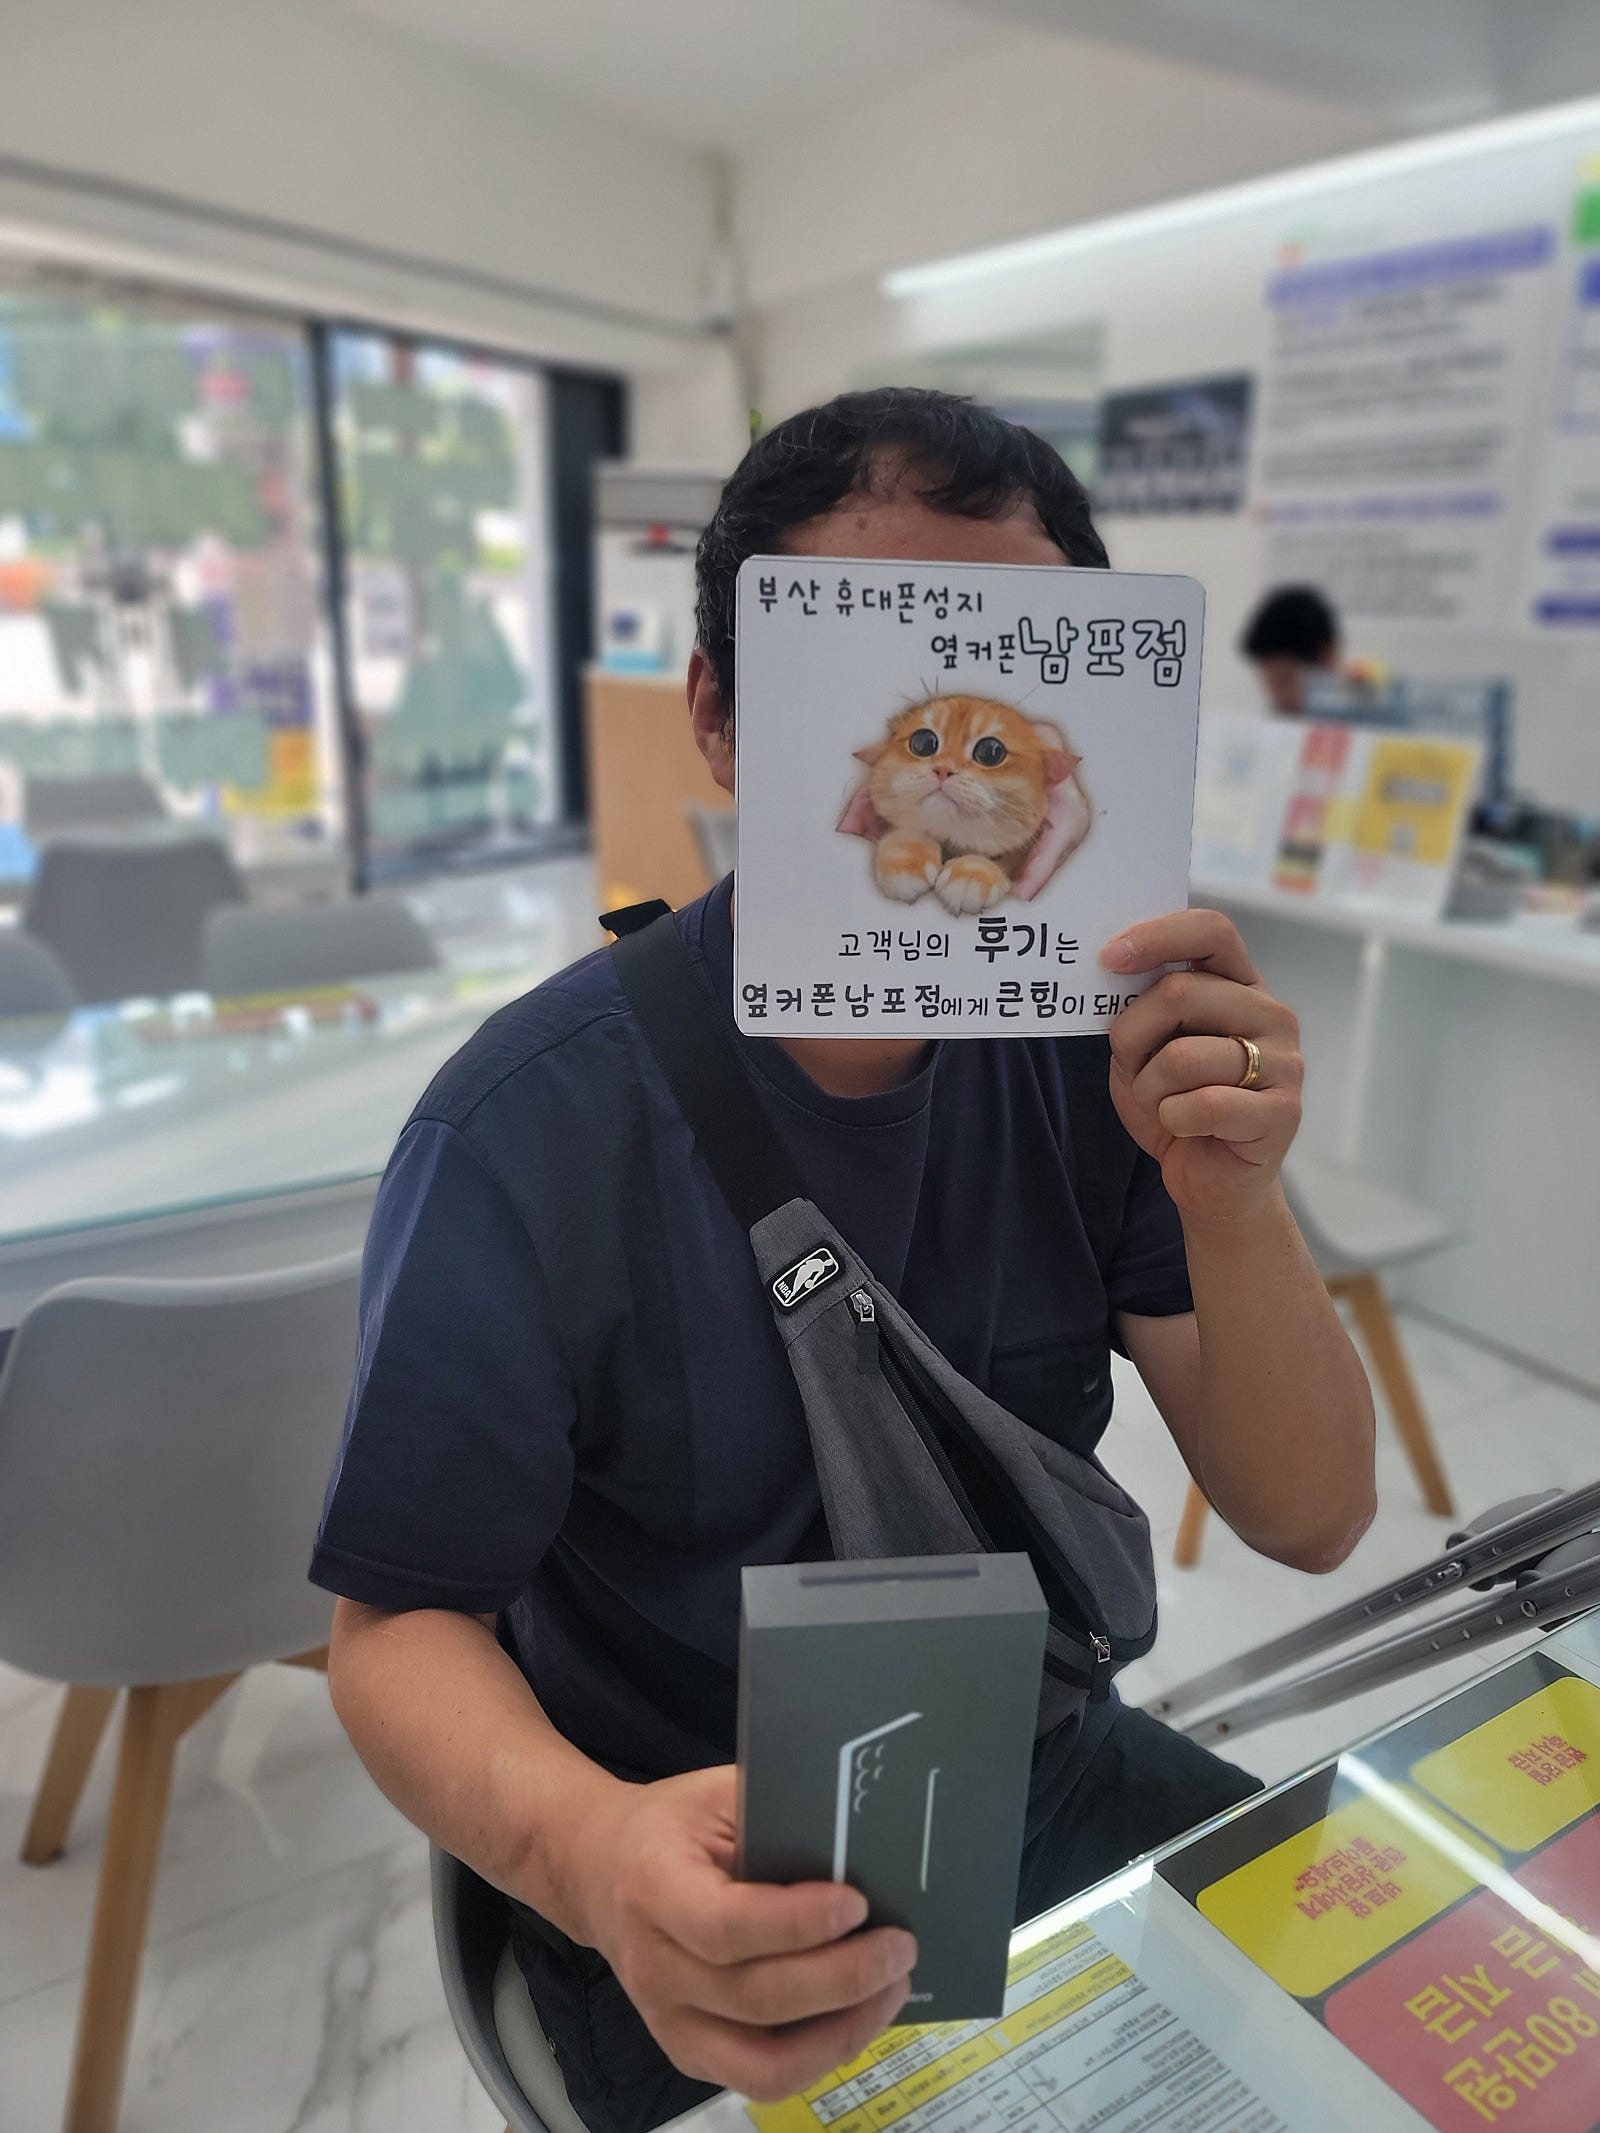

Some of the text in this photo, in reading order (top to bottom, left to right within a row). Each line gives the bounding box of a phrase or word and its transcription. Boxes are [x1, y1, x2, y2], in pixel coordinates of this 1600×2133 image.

[758, 576, 983, 624] 부산 휴대폰성지
[838, 916, 1080, 965] 고객님의 후기는
[777, 1281, 792, 1298] NBA
[1508, 1750, 1542, 1771] 지급
[1296, 1865, 1377, 1920] 상담사에게
[1362, 1881, 1403, 1907] 바로
[1403, 1963, 1513, 2044] 지급
[1442, 1994, 1599, 2123] 80만원
